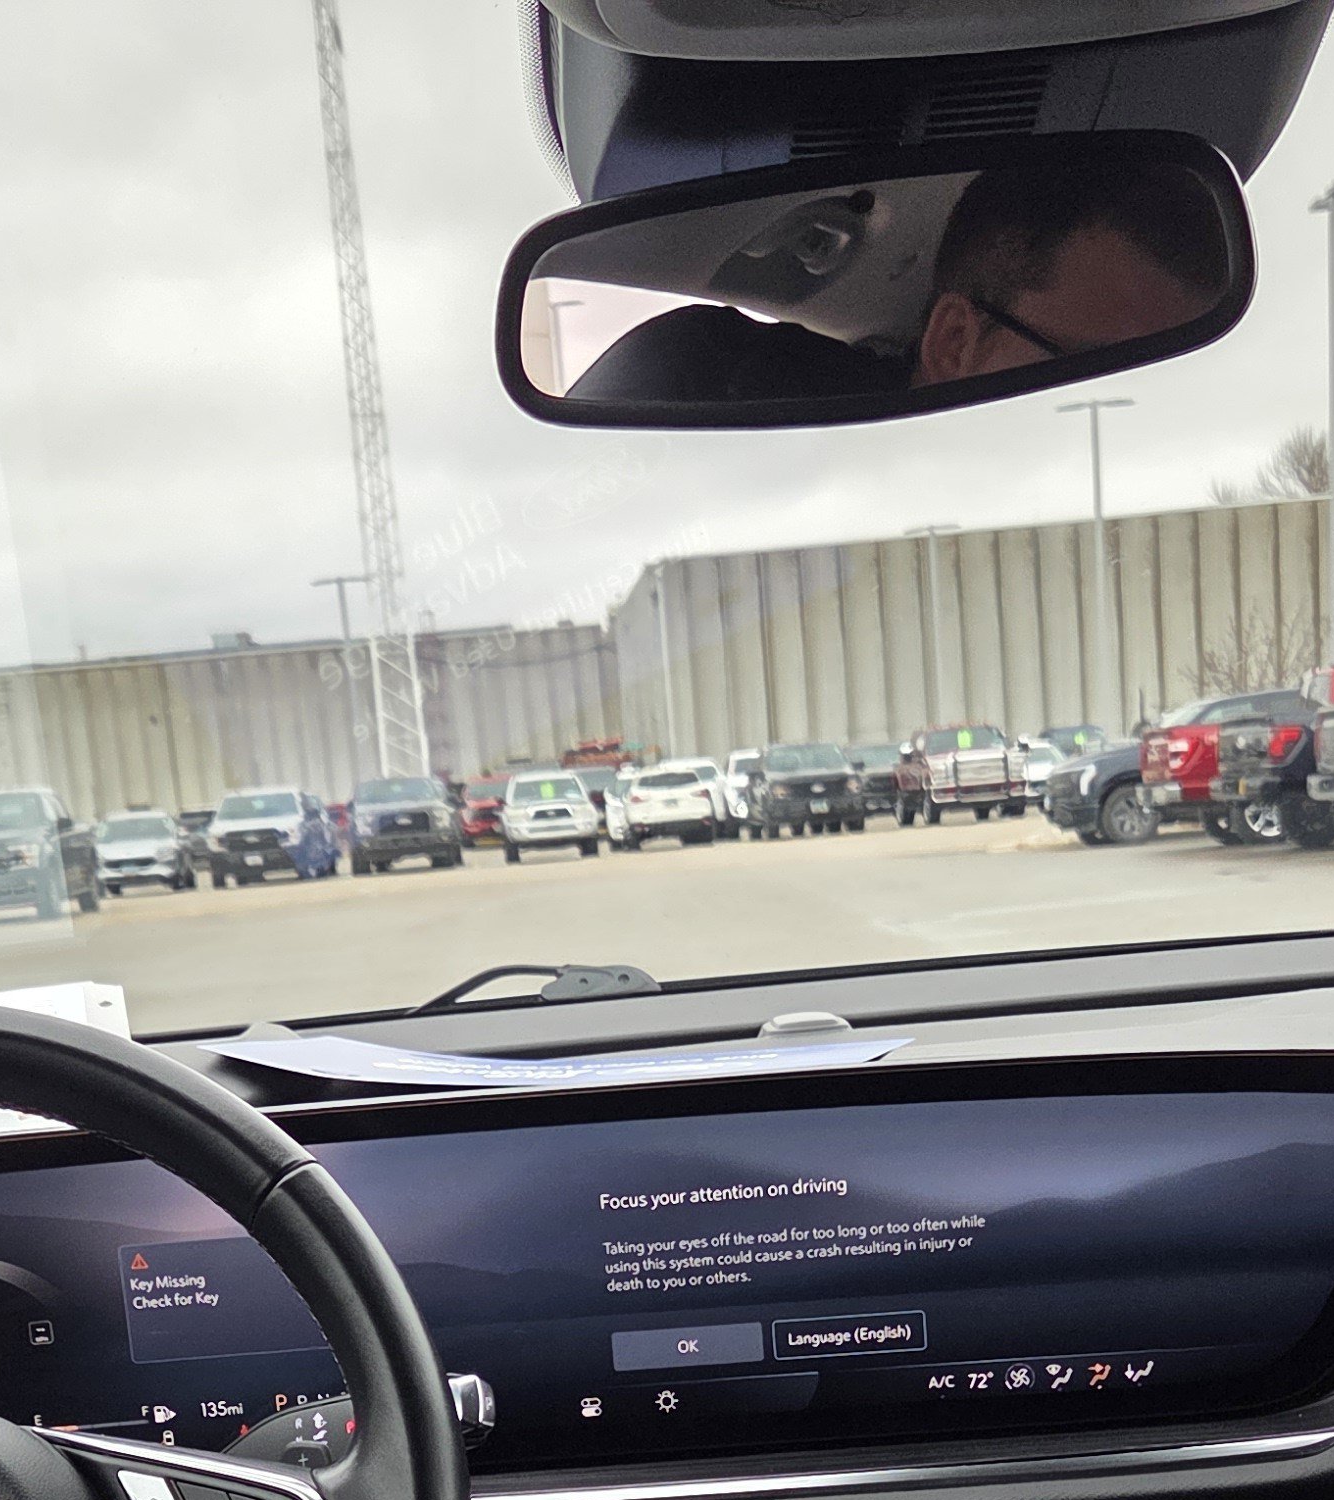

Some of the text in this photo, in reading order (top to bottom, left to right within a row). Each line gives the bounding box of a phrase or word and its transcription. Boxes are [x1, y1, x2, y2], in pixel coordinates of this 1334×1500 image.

[599, 1177, 848, 1210] Focus your attention on driving
[603, 1214, 986, 1257] Taking your eyes off the road for too long or too often while
[605, 1236, 973, 1275] using this system could cause a crash resulting in injury or
[130, 1274, 206, 1293] Key Missing
[607, 1271, 752, 1292] death to you or others.
[133, 1292, 219, 1310] Check for Key
[788, 1325, 912, 1347] Language (English)
[677, 1339, 700, 1354] OK
[928, 1375, 955, 1389] A/C
[141, 1405, 150, 1417] F
[200, 1401, 244, 1418] 135mi
[275, 1394, 288, 1412] P
[33, 1415, 44, 1427] E
